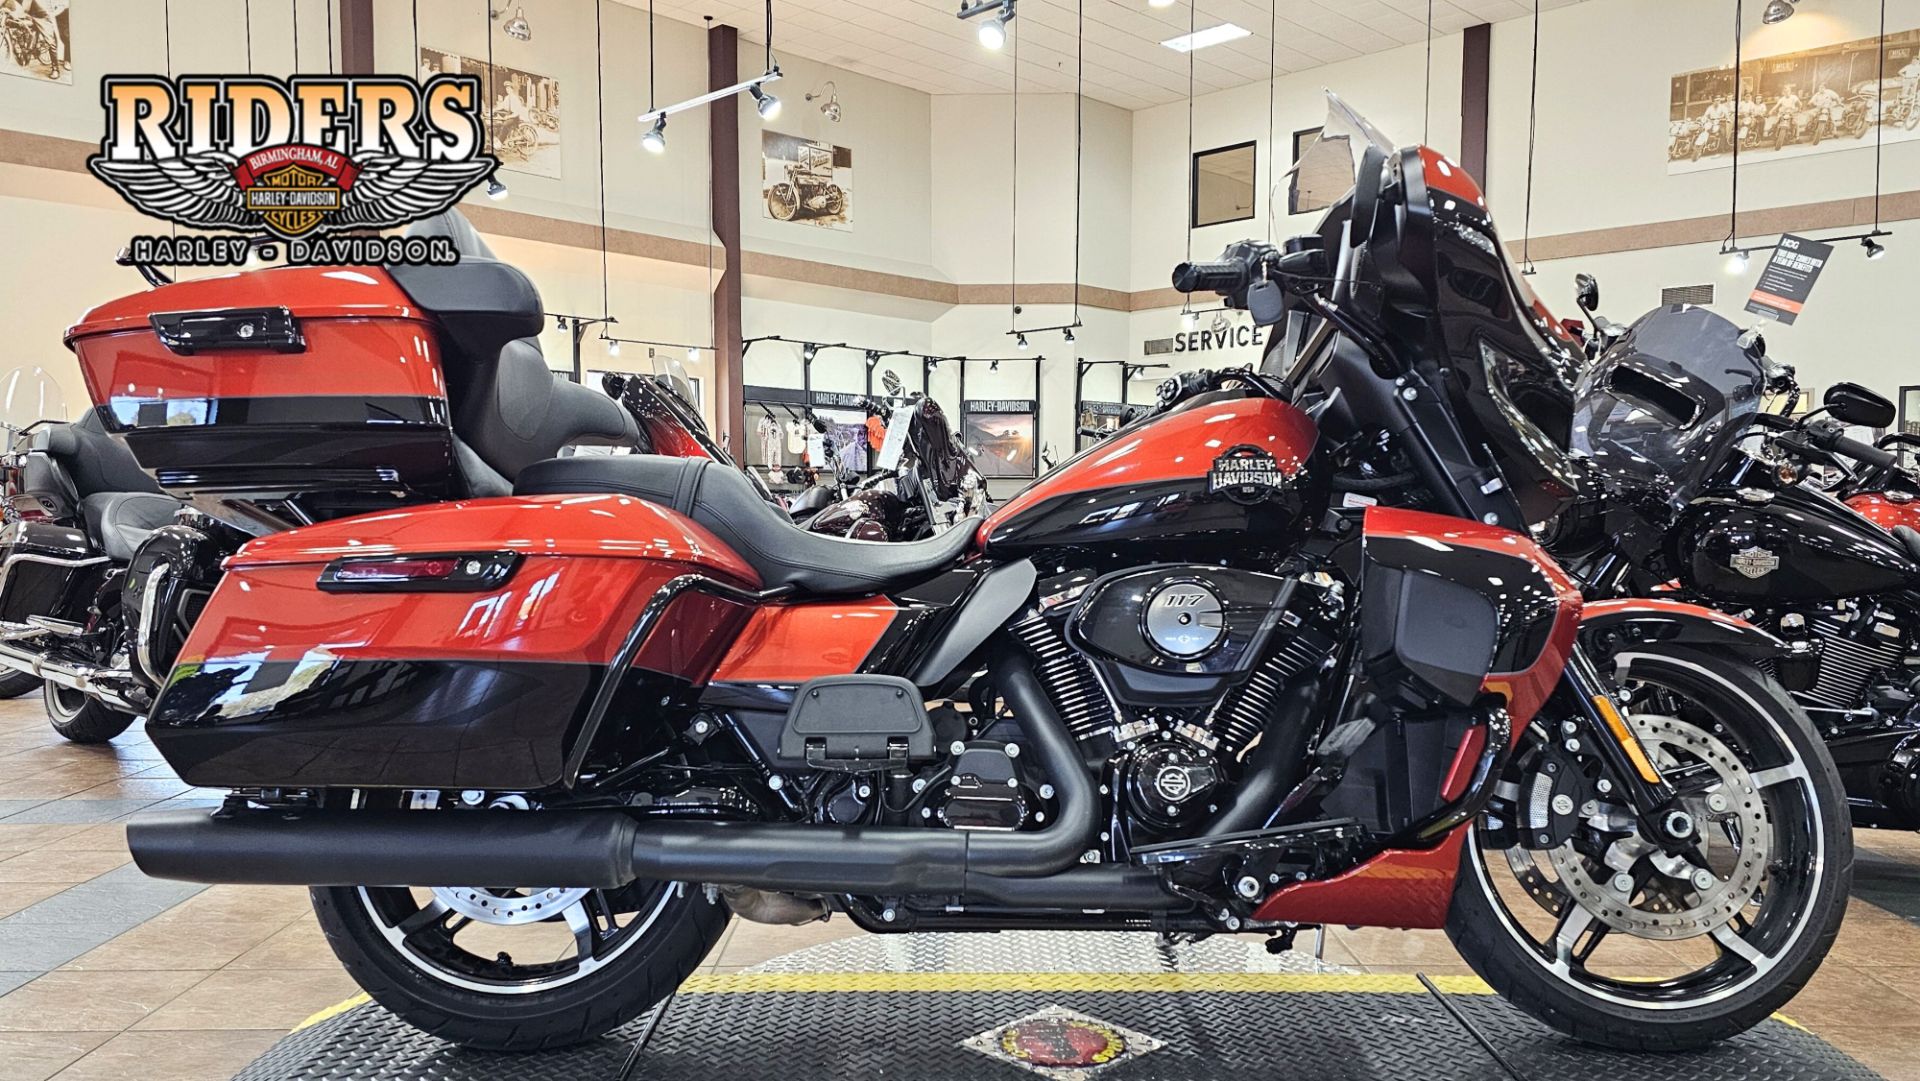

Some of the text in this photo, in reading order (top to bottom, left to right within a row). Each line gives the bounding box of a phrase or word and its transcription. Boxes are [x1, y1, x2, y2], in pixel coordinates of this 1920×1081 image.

[1174, 325, 1263, 352] SERVICE
[1212, 471, 1282, 490] DAVIDSON
[1165, 594, 1207, 607] 117
